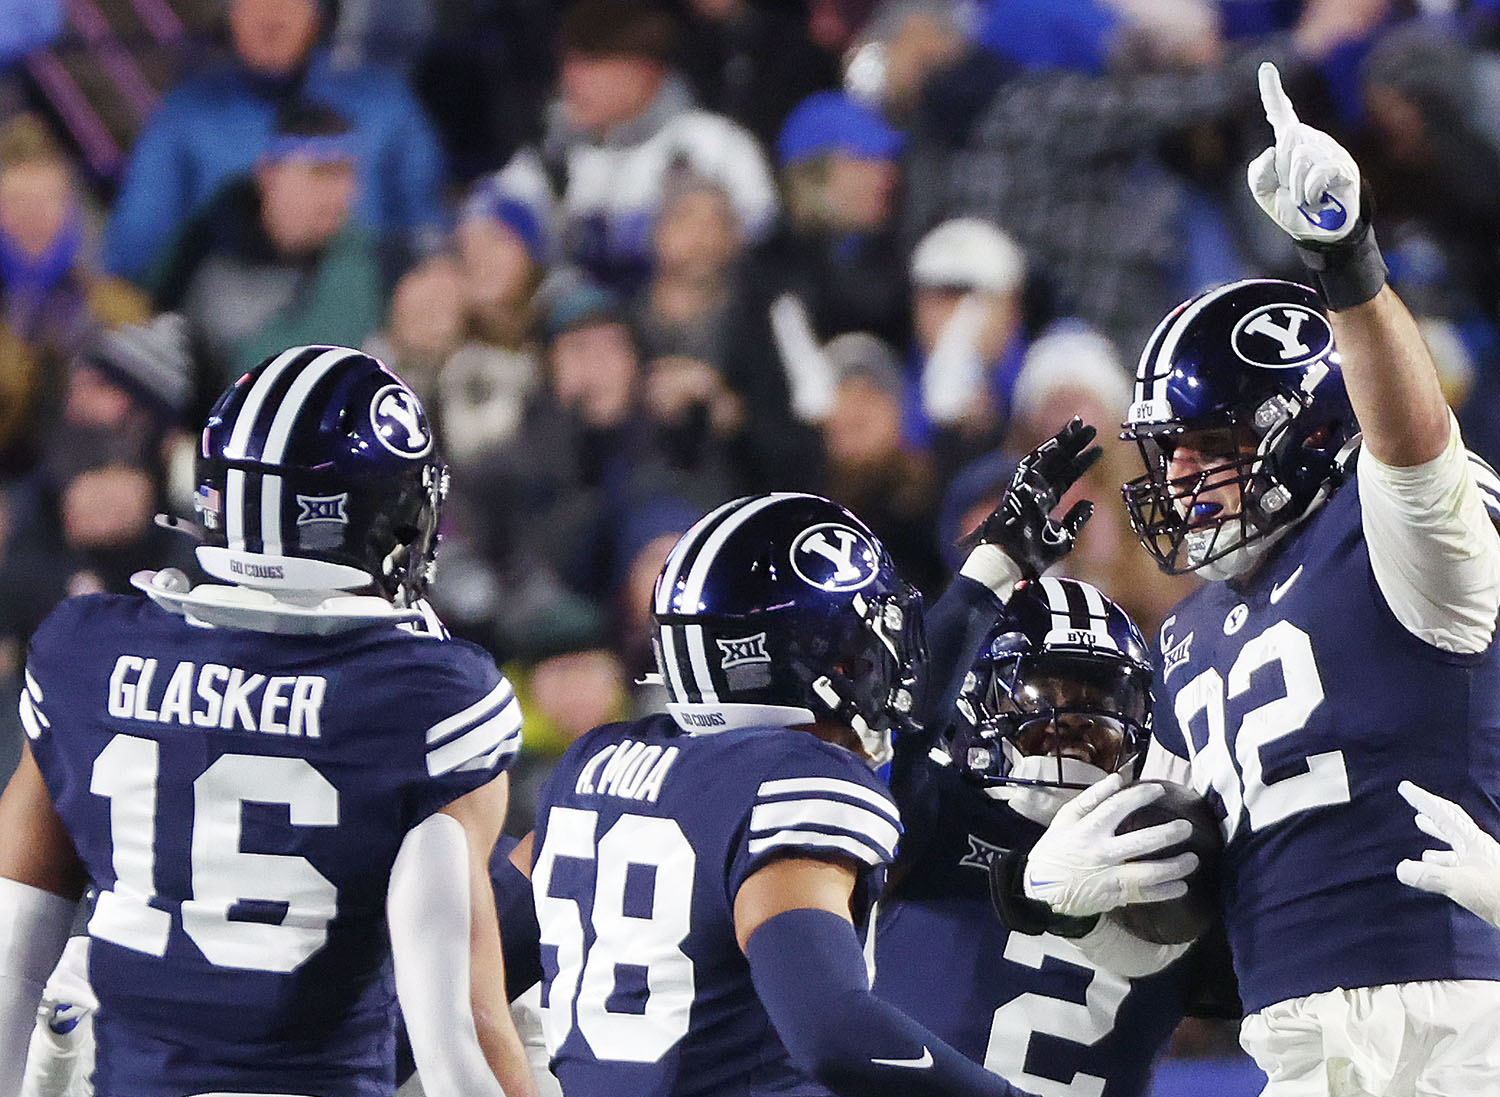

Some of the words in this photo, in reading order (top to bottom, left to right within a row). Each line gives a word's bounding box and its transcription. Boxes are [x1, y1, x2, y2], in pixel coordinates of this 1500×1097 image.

[1244, 309, 1310, 360] Y
[377, 391, 428, 449] Y
[1136, 403, 1153, 419] BYU
[230, 559, 243, 574] GO
[244, 563, 284, 579] COUGS
[800, 529, 861, 582] Y
[1067, 630, 1096, 646] BYU
[107, 655, 328, 739] GLASKER
[680, 711, 693, 725] GO
[691, 712, 726, 727] COUGS
[88, 733, 340, 974] 16
[531, 806, 697, 1063] 58
